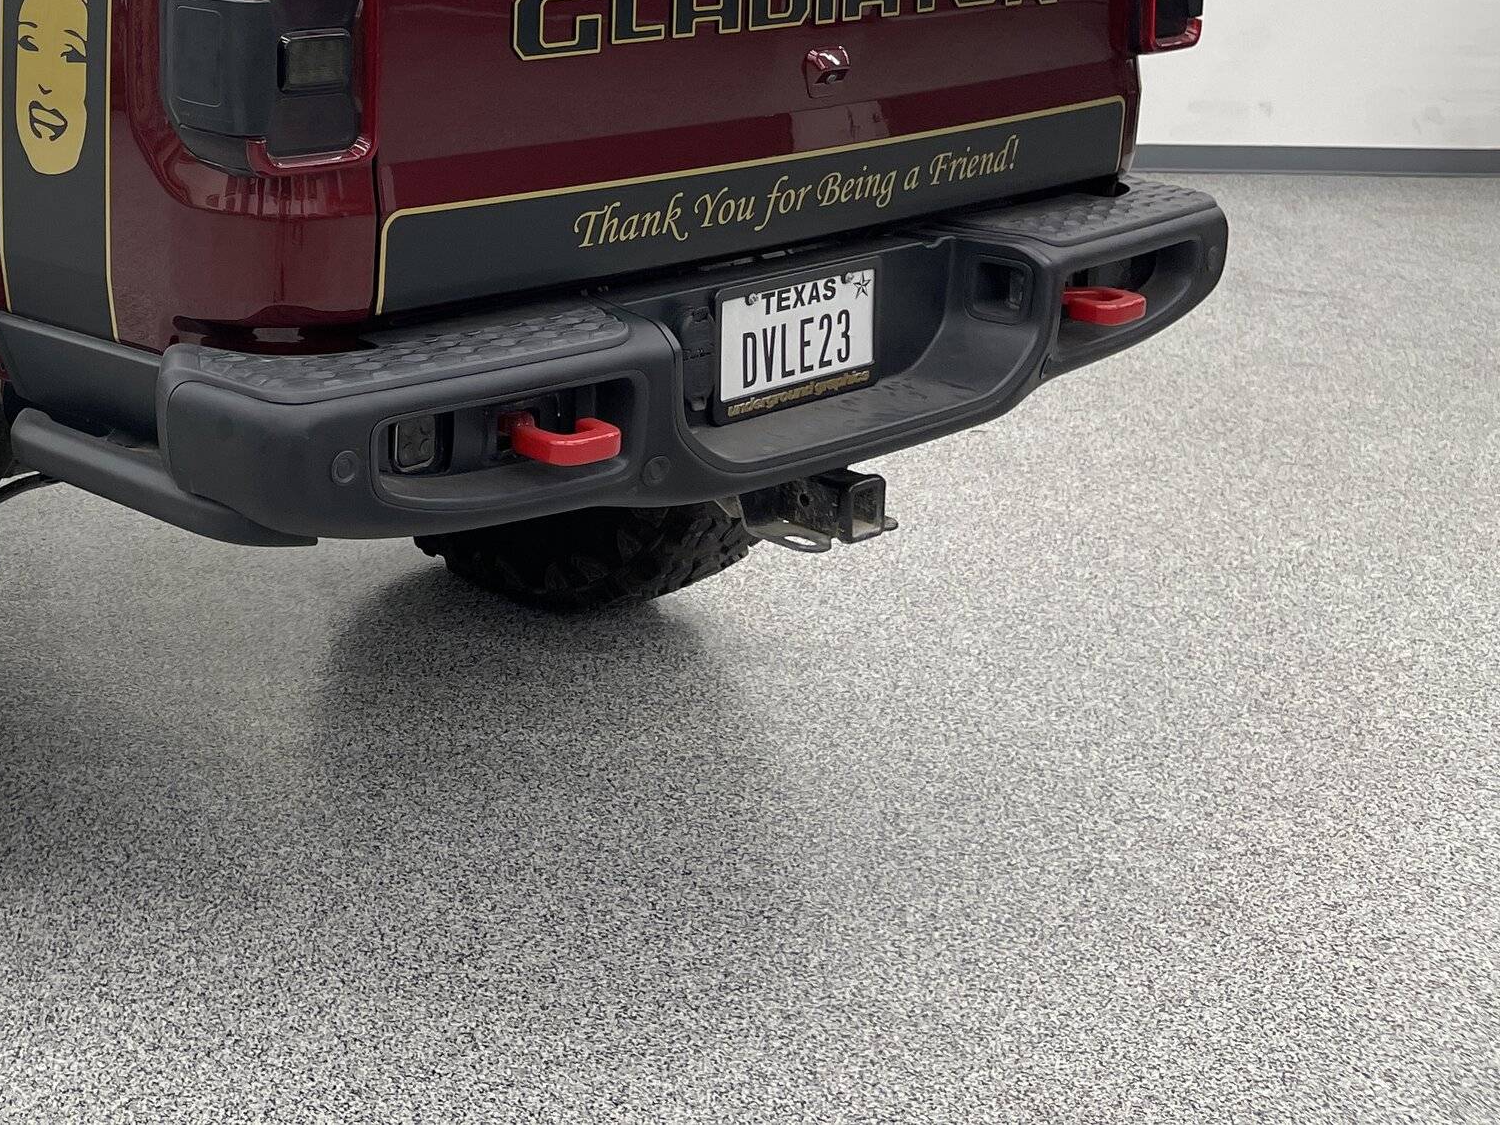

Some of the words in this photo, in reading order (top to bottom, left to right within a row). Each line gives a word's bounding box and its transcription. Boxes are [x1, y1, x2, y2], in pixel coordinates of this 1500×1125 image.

[573, 191, 690, 249] Thank
[693, 186, 756, 228] You
[754, 175, 812, 232] for
[816, 164, 895, 209] Being
[902, 166, 920, 192] a
[928, 133, 1020, 187] Friend!
[761, 278, 837, 316] TEXAS
[742, 308, 851, 390] DVLE23
[727, 382, 814, 417] underground
[814, 370, 870, 394] graphics
